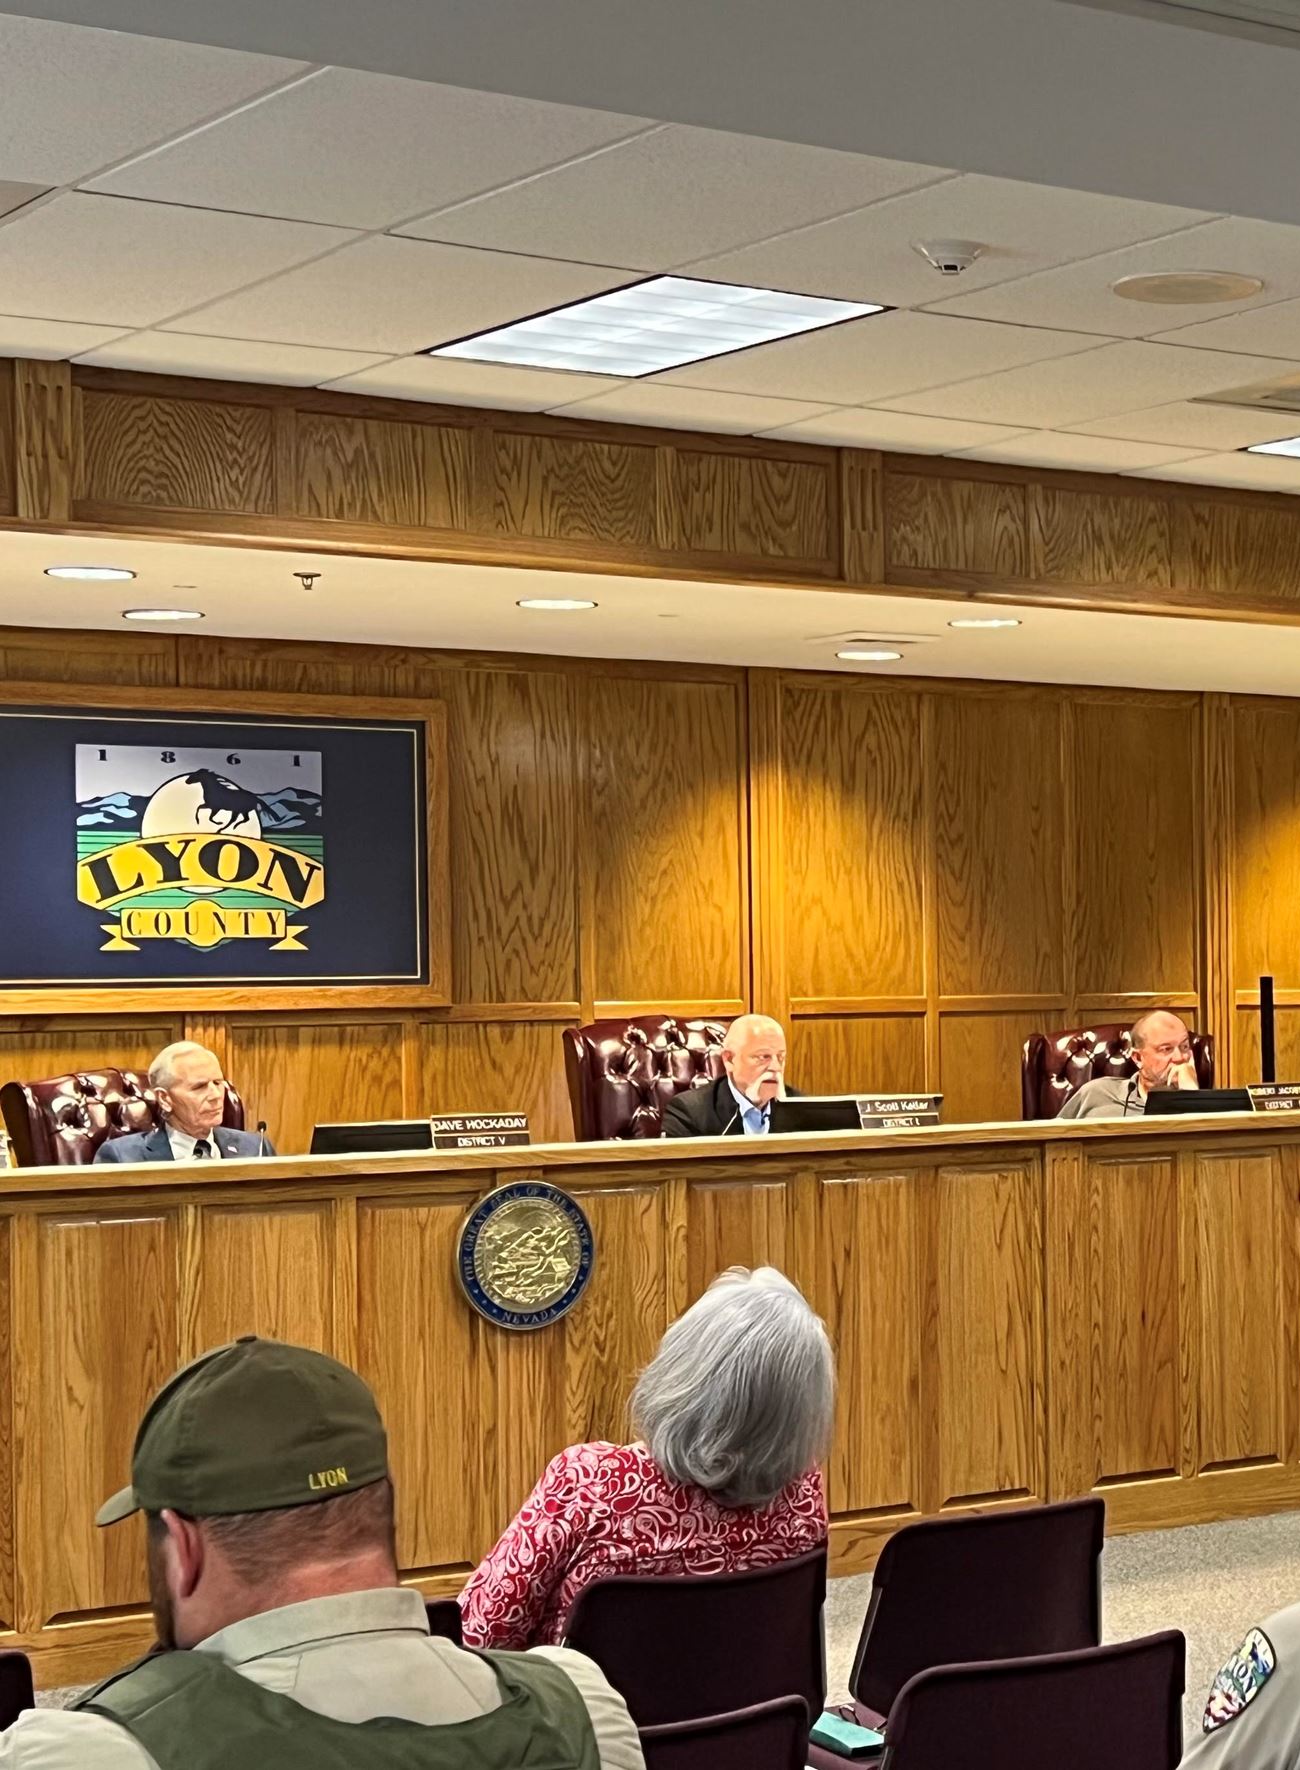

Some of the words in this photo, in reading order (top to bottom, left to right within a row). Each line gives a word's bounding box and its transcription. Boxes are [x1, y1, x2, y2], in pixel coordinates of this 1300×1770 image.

[82, 839, 322, 904] LYON
[126, 910, 282, 937] COUNTY
[433, 1119, 464, 1132] DAVE
[466, 1117, 528, 1130] HOCKADAY
[502, 1307, 559, 1324] NEVADA
[308, 1466, 348, 1490] LYON
